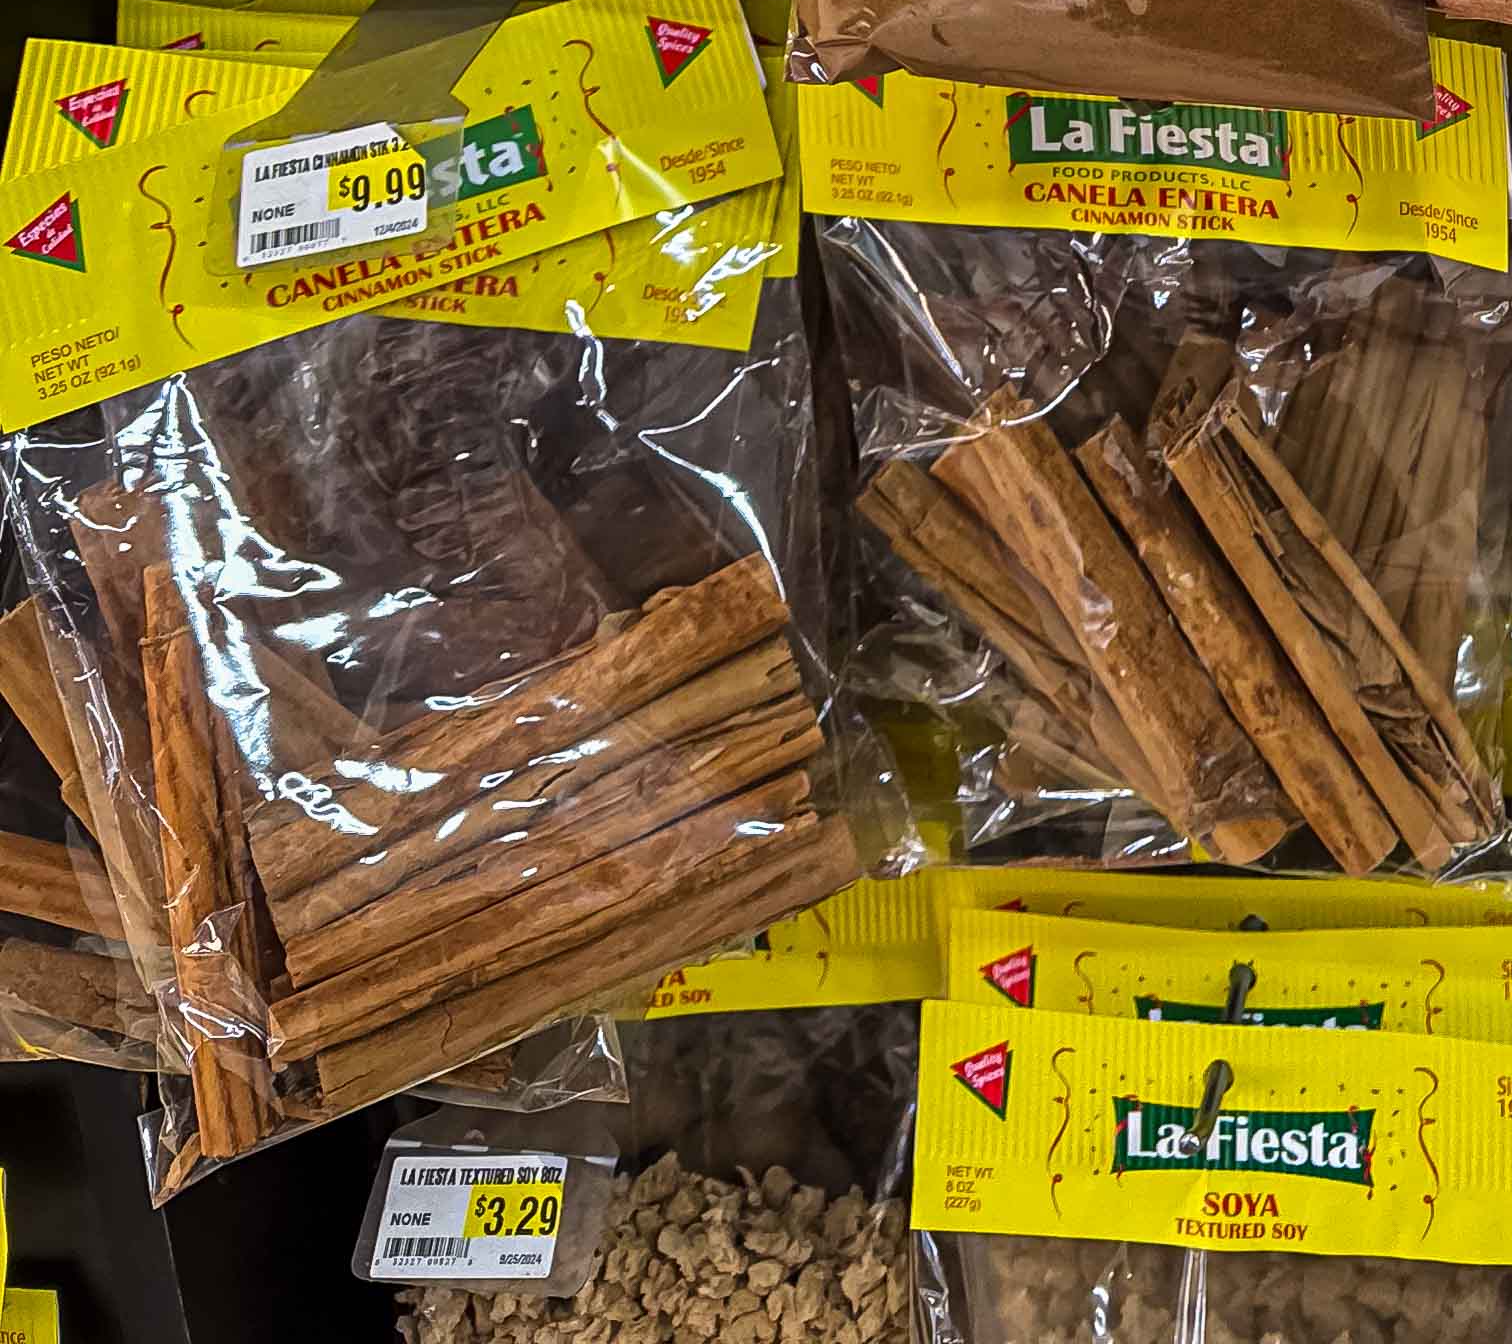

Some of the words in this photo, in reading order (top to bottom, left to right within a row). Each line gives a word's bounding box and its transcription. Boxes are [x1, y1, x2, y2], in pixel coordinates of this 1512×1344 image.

[1030, 106, 1095, 153] La
[1109, 108, 1270, 167] Fiesta
[339, 163, 426, 212] $9.99
[1052, 166, 1103, 179] FOOD
[1111, 169, 1214, 187] PRODUCTS,
[1221, 176, 1251, 192] LLC
[252, 204, 296, 223] NONE
[476, 194, 511, 215] LLC
[1024, 182, 1146, 208] CANELA
[1159, 188, 1279, 219] ENTERA
[1071, 208, 1170, 227] CINNAMON
[1177, 214, 1235, 232] STICK
[1400, 201, 1479, 230] Desde/Since
[1424, 221, 1457, 244] 1954
[265, 251, 402, 308] CANELA
[322, 263, 433, 313] CINNAMON
[439, 243, 503, 274] STICK
[31, 343, 72, 368] PESO
[75, 327, 119, 353] NETO/
[34, 363, 63, 384] NET
[67, 354, 90, 372] WT
[1126, 1111, 1187, 1158] La
[1206, 1114, 1361, 1169] Fiesta
[390, 1213, 432, 1226] NONE
[475, 1194, 559, 1236] $3.29
[1203, 1192, 1279, 1218] SOYA
[1175, 1218, 1266, 1240] TEXTURED
[1272, 1223, 1308, 1241] SOY
